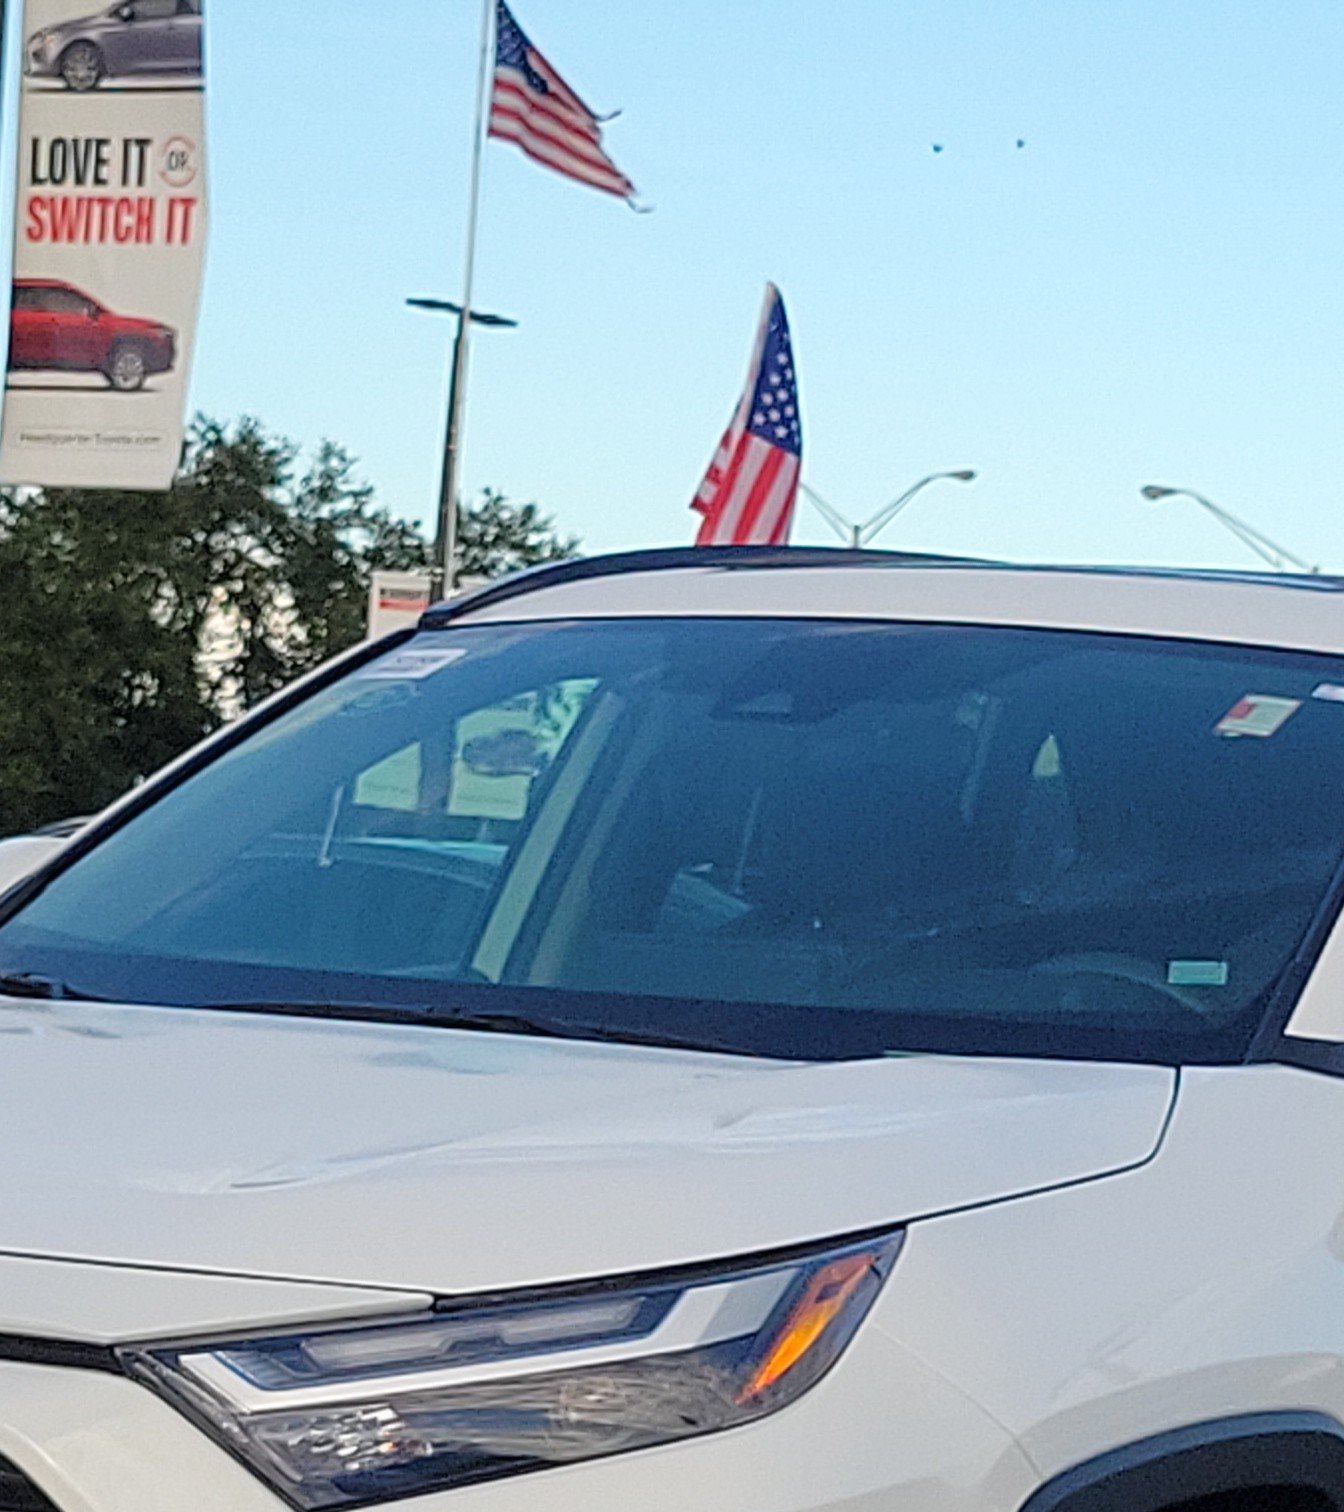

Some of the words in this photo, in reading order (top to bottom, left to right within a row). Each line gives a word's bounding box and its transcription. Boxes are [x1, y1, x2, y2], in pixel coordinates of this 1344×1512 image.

[31, 137, 111, 186] LOVE
[121, 138, 153, 187] IT
[26, 196, 155, 243] SWITCH
[165, 198, 198, 244] IT
